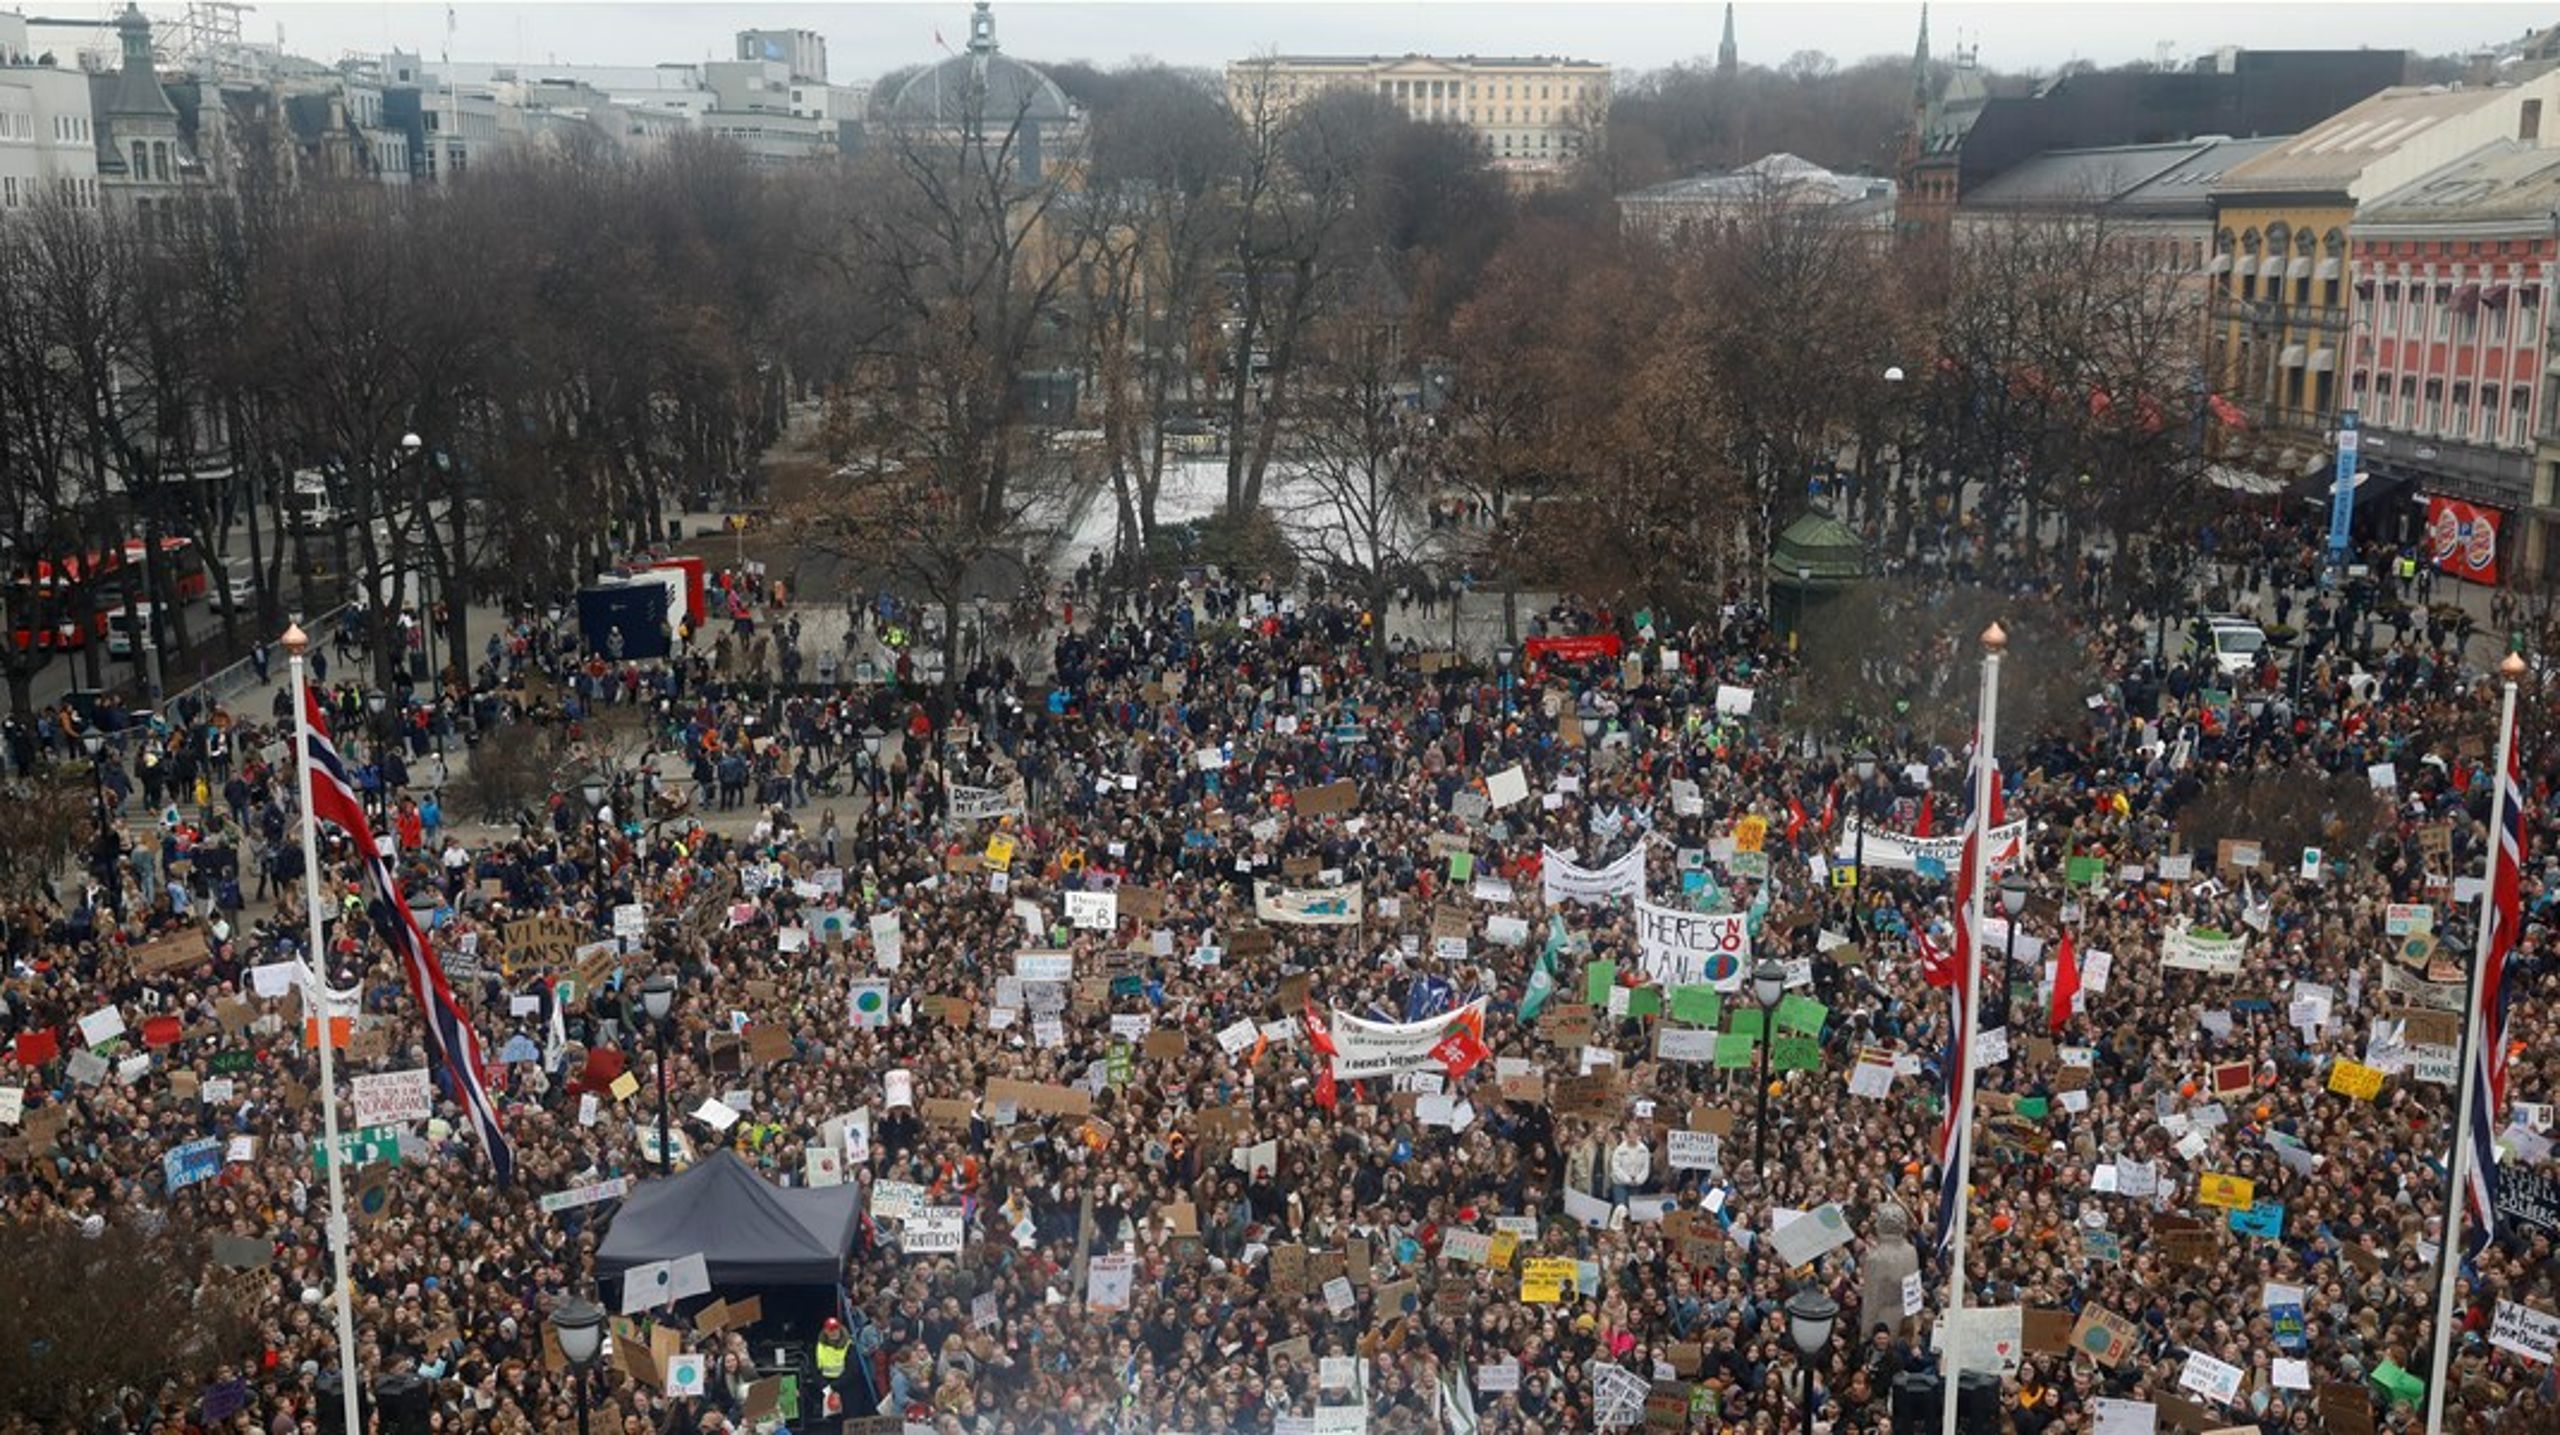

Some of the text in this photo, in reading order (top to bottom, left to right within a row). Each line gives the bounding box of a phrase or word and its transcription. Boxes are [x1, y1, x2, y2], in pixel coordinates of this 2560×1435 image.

[956, 803, 974, 812] MY
[506, 924, 531, 944] VI
[1635, 908, 1725, 952] THERE'S
[1722, 918, 1740, 951] NO
[313, 1127, 394, 1152] TRE IS
